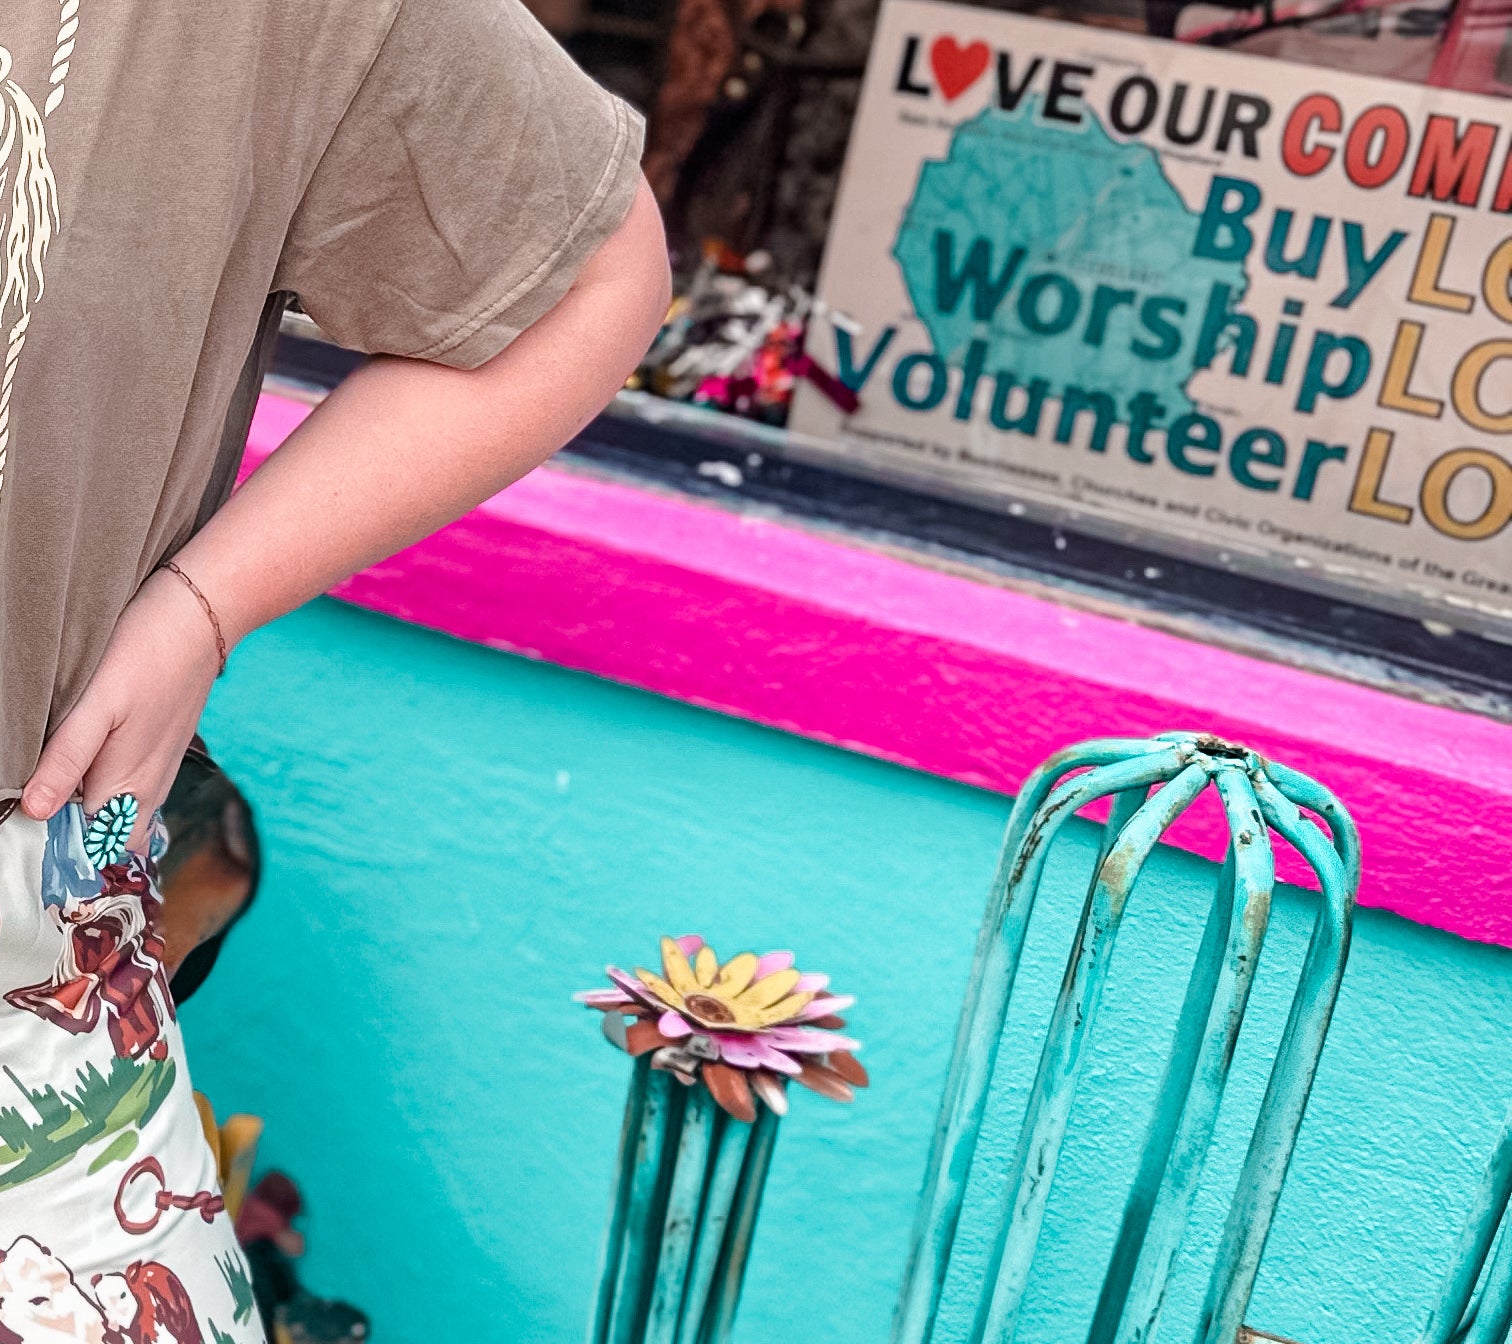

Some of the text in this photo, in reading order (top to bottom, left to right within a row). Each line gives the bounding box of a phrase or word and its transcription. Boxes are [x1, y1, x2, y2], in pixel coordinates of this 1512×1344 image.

[1109, 74, 1272, 160] OUR
[1192, 173, 1409, 309] Buy
[933, 228, 1373, 415] Worship
[832, 323, 1347, 502] Volunteer
[1257, 518, 1392, 567] Organizations
[1397, 553, 1421, 573] of
[1423, 561, 1457, 582] the
